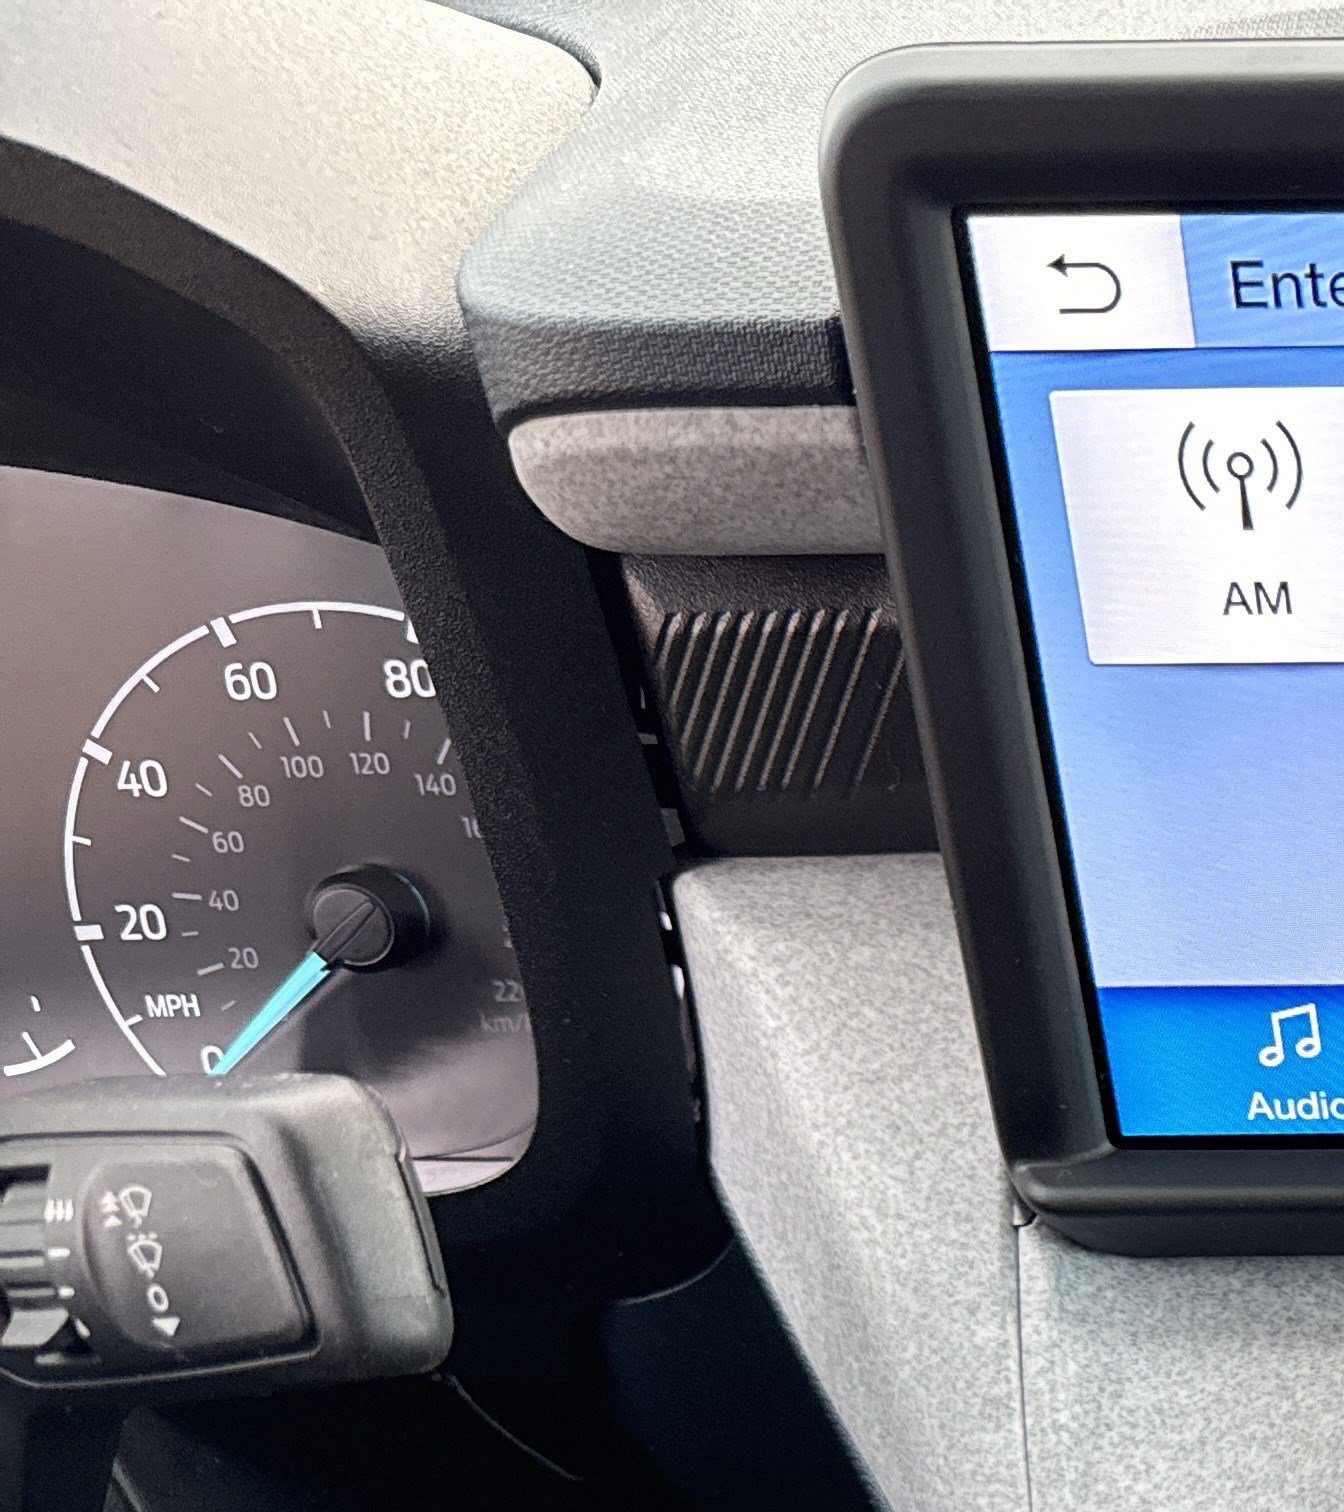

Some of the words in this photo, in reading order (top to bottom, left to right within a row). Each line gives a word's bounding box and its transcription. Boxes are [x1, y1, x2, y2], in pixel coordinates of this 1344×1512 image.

[1222, 581, 1293, 616] AM
[224, 661, 277, 700] 60
[383, 658, 436, 698] 80
[280, 755, 324, 778] 100
[350, 752, 390, 775] 120
[117, 760, 168, 798] 40
[415, 773, 456, 796] 140
[237, 785, 270, 807] 80
[211, 831, 244, 853] 60
[208, 890, 239, 911] 40
[114, 904, 167, 940] 20
[228, 947, 258, 969] 20
[144, 994, 201, 1018] MPH
